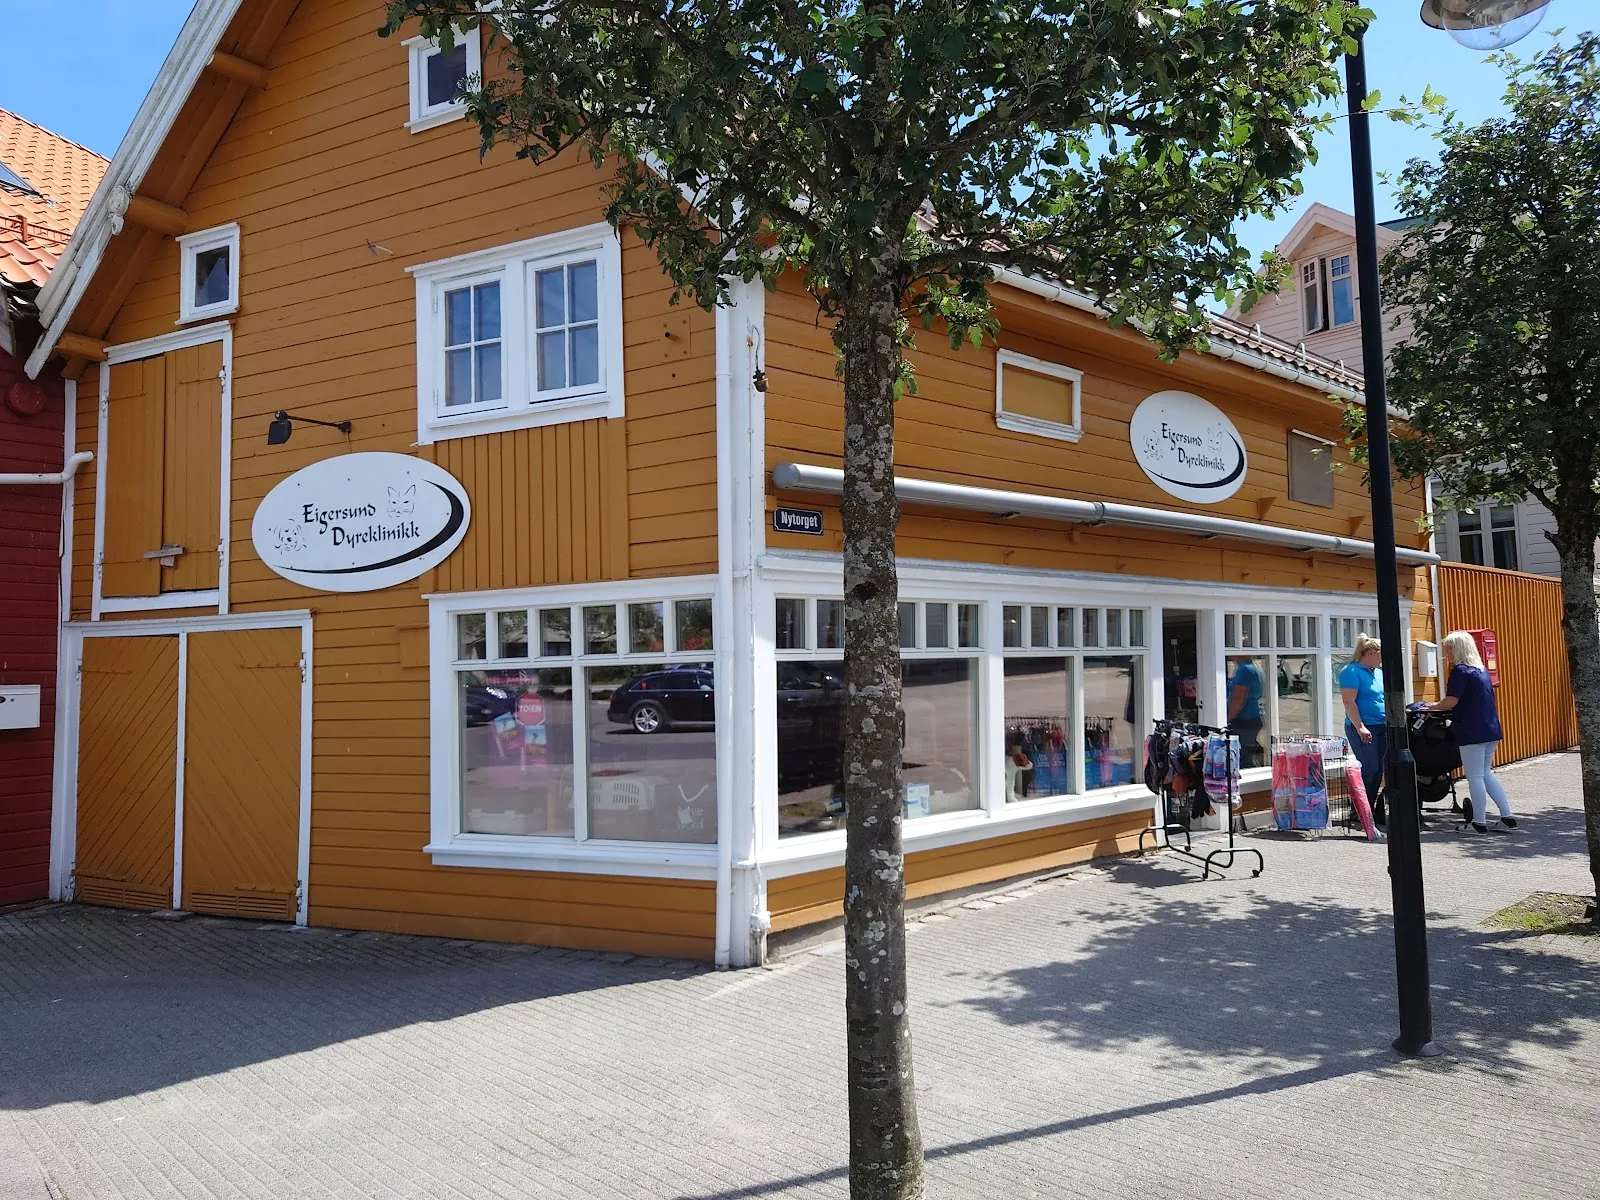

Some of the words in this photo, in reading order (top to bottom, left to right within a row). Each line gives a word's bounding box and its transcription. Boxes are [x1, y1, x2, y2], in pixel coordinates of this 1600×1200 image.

[1161, 422, 1203, 451] Eigersund
[1177, 447, 1225, 471] Dyreklinikk
[302, 503, 376, 534] Eigersund
[780, 510, 818, 529] Nytorget
[331, 520, 421, 548] Dyreklinikk
